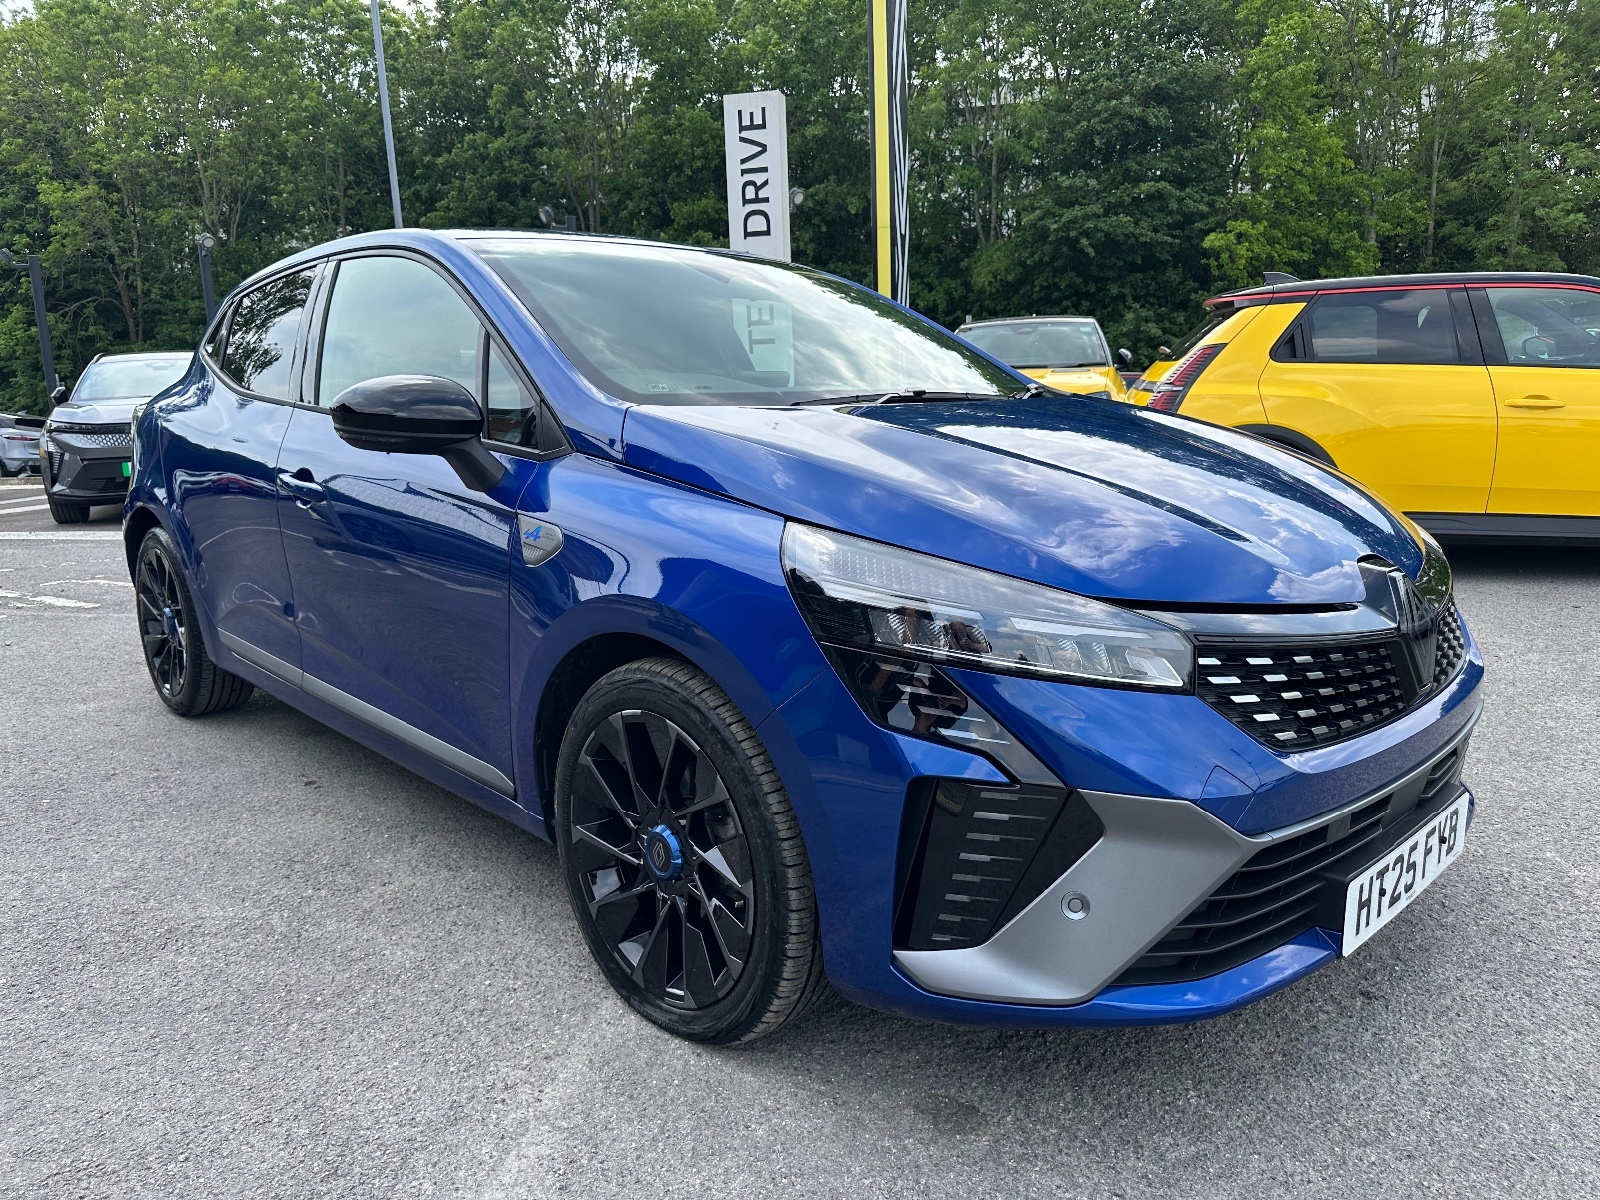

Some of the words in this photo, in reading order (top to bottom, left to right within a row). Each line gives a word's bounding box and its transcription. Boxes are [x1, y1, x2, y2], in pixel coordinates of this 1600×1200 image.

[737, 106, 771, 240] DRIVE
[746, 303, 776, 355] TE
[1355, 840, 1419, 937] HT25
[1421, 807, 1459, 880] FYB
